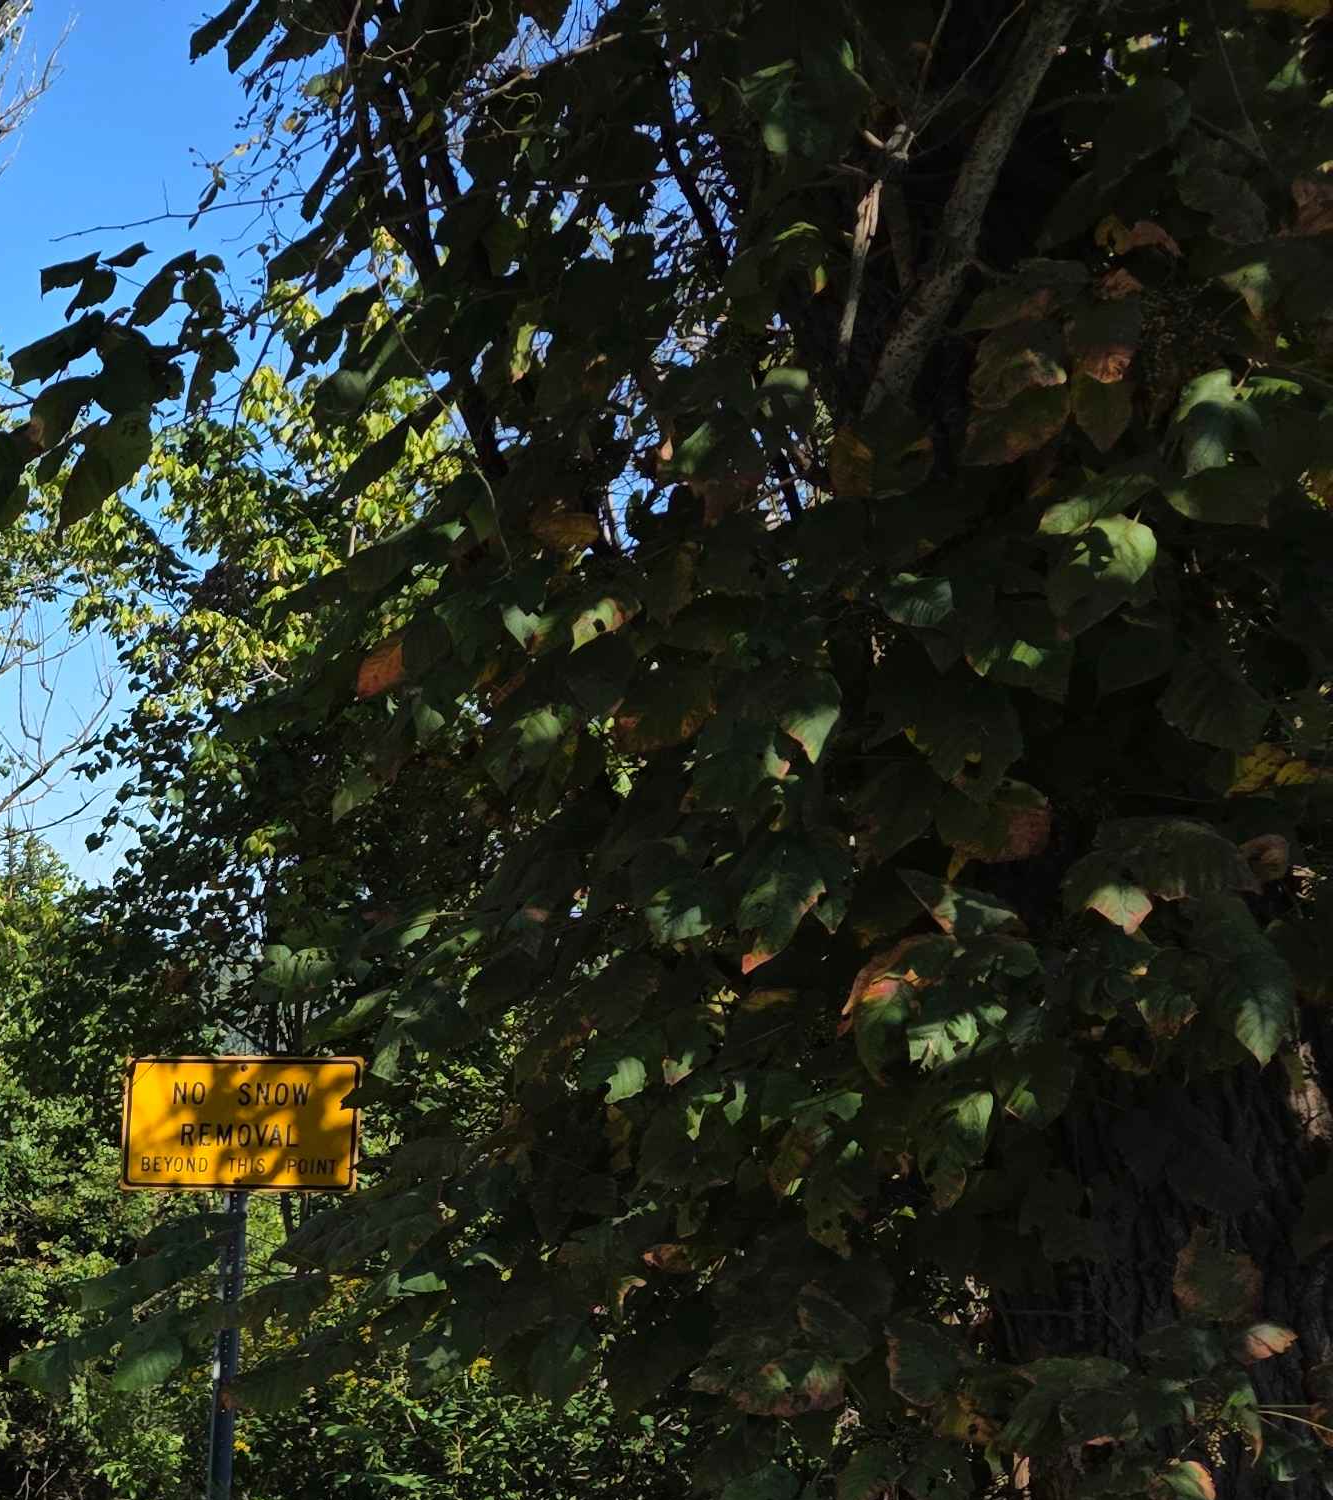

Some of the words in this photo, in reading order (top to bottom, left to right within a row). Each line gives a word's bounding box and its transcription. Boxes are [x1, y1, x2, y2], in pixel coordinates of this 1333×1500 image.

[172, 1081, 206, 1105] NO
[237, 1082, 311, 1107] SNOW
[180, 1123, 299, 1147] REMOVAL
[141, 1156, 209, 1174] BEYOND
[228, 1157, 266, 1175] THIS
[285, 1158, 338, 1176] POINT
